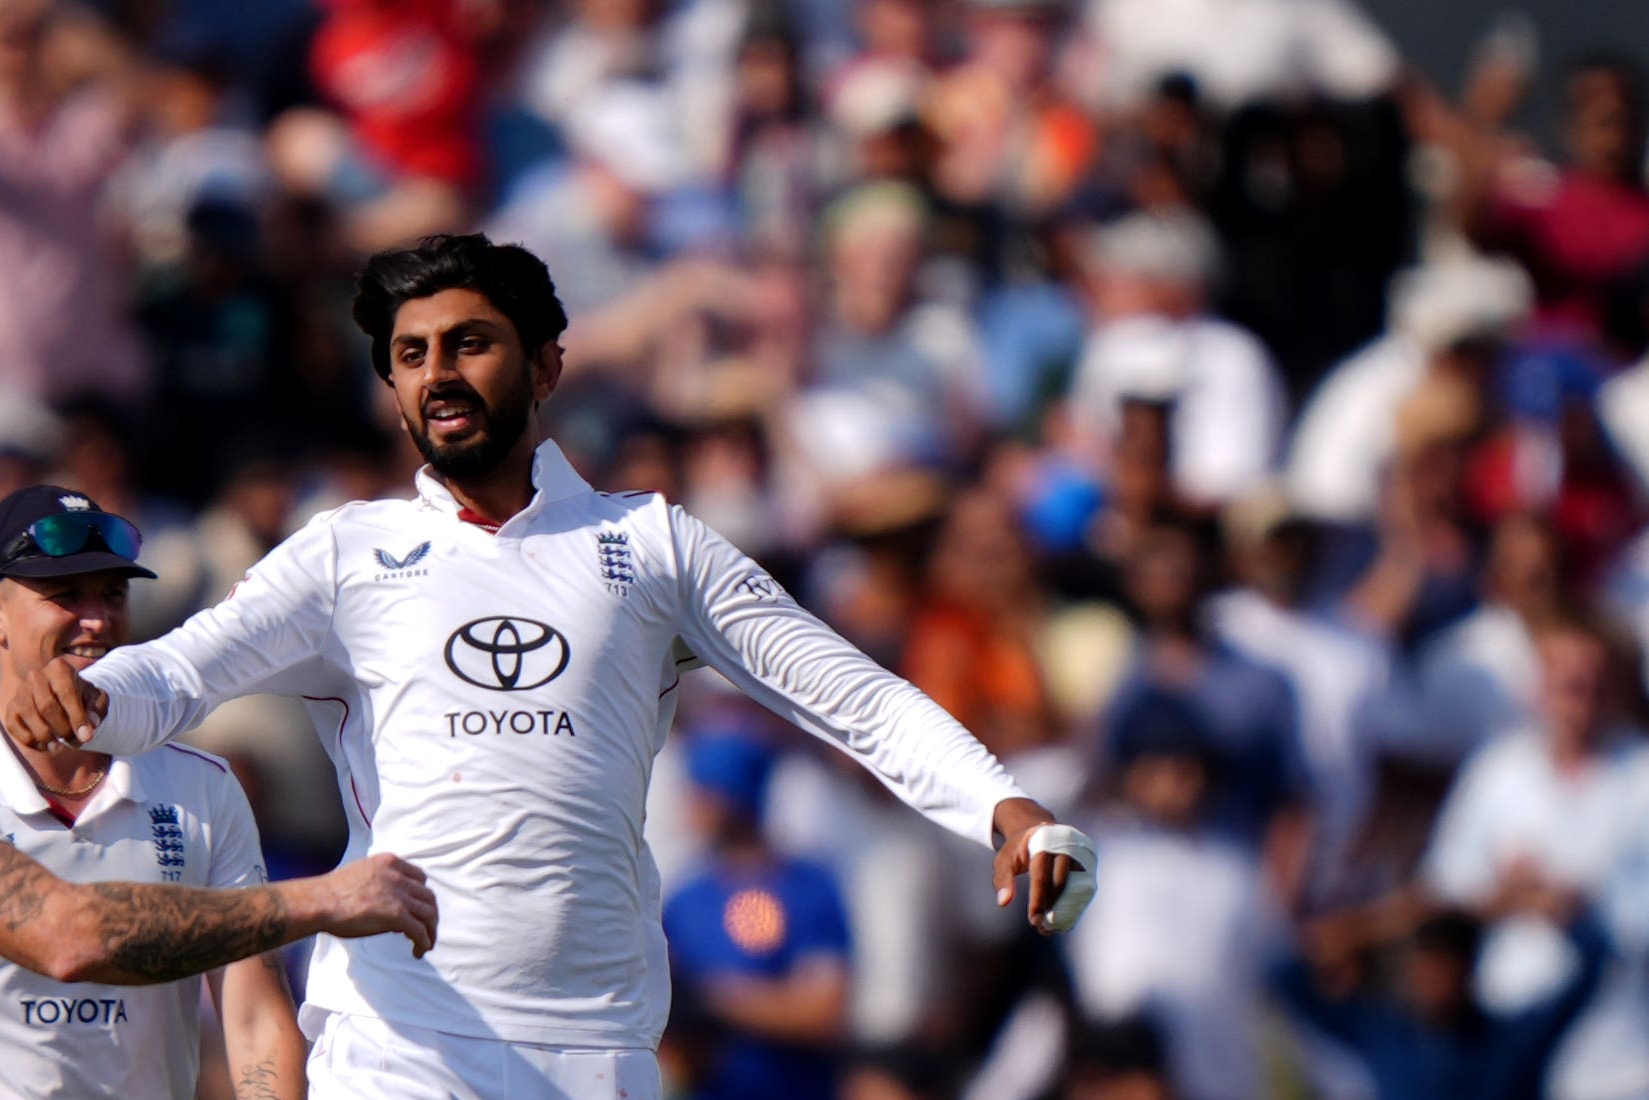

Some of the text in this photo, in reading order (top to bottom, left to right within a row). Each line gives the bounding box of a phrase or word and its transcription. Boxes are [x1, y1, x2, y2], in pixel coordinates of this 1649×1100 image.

[605, 582, 628, 597] 713
[444, 710, 576, 738] TOYOTA
[160, 870, 182, 882] 717
[20, 998, 128, 1024] TOYOTA
